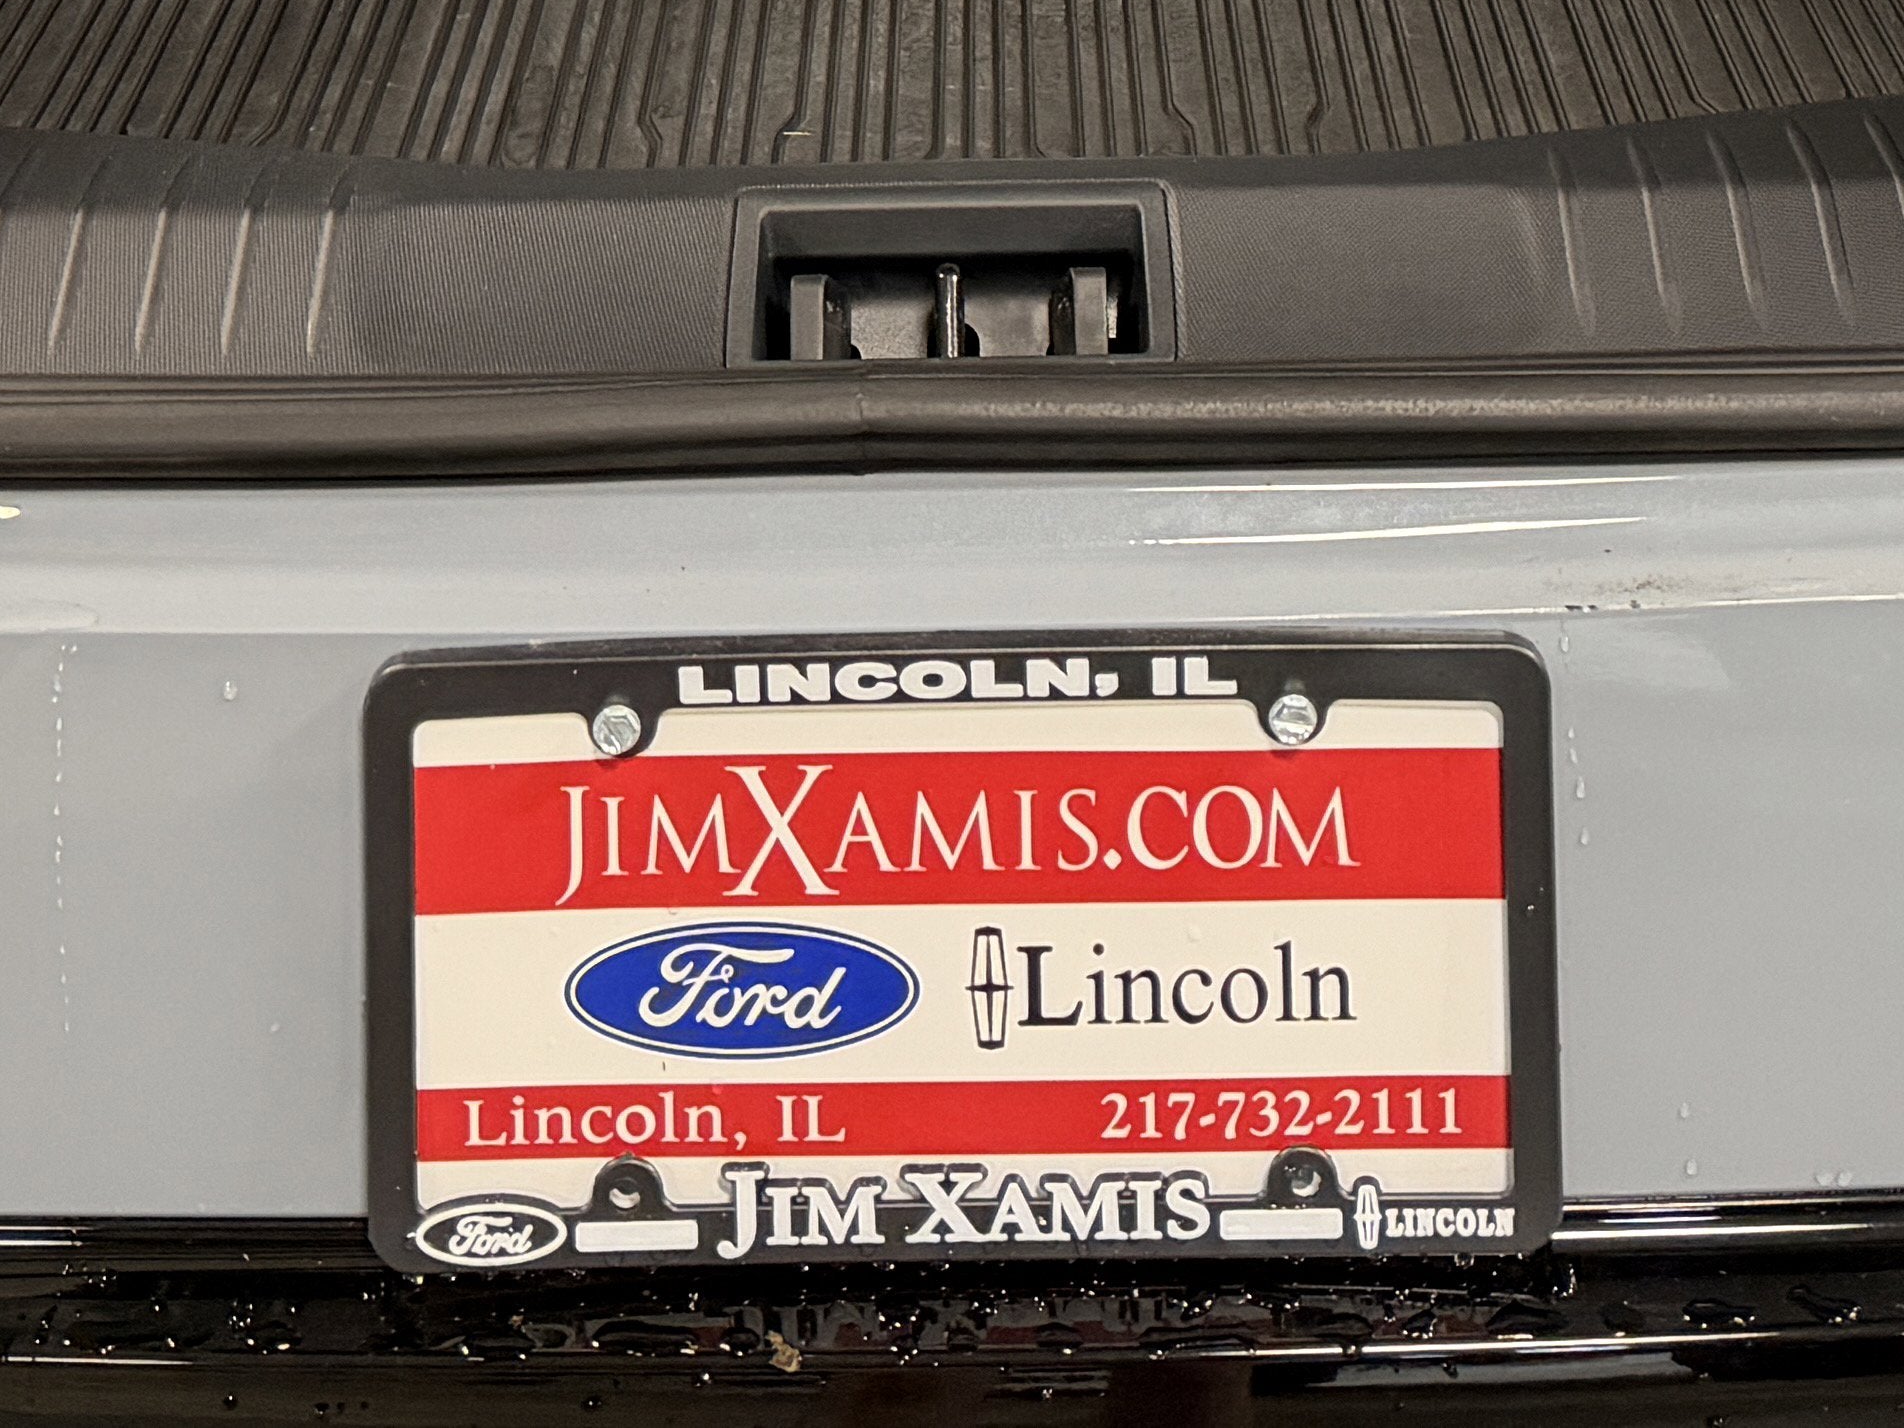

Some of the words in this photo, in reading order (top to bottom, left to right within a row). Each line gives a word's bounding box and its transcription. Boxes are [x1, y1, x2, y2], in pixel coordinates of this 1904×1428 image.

[678, 658, 1121, 705] LINCOLN,
[1149, 657, 1239, 697] IL
[556, 765, 1361, 905] JIMXAMIS.COM
[639, 942, 843, 1030] Ford
[1018, 941, 1357, 1026] Lincoln
[464, 1097, 748, 1153] Lincoln,
[778, 1095, 846, 1143] IL
[1099, 1089, 1463, 1141] 217-732-2111
[446, 1216, 534, 1256] Ford
[718, 1171, 882, 1257] JIM
[903, 1168, 1212, 1243] XAMIS
[1386, 1208, 1516, 1238] LINCOLN
